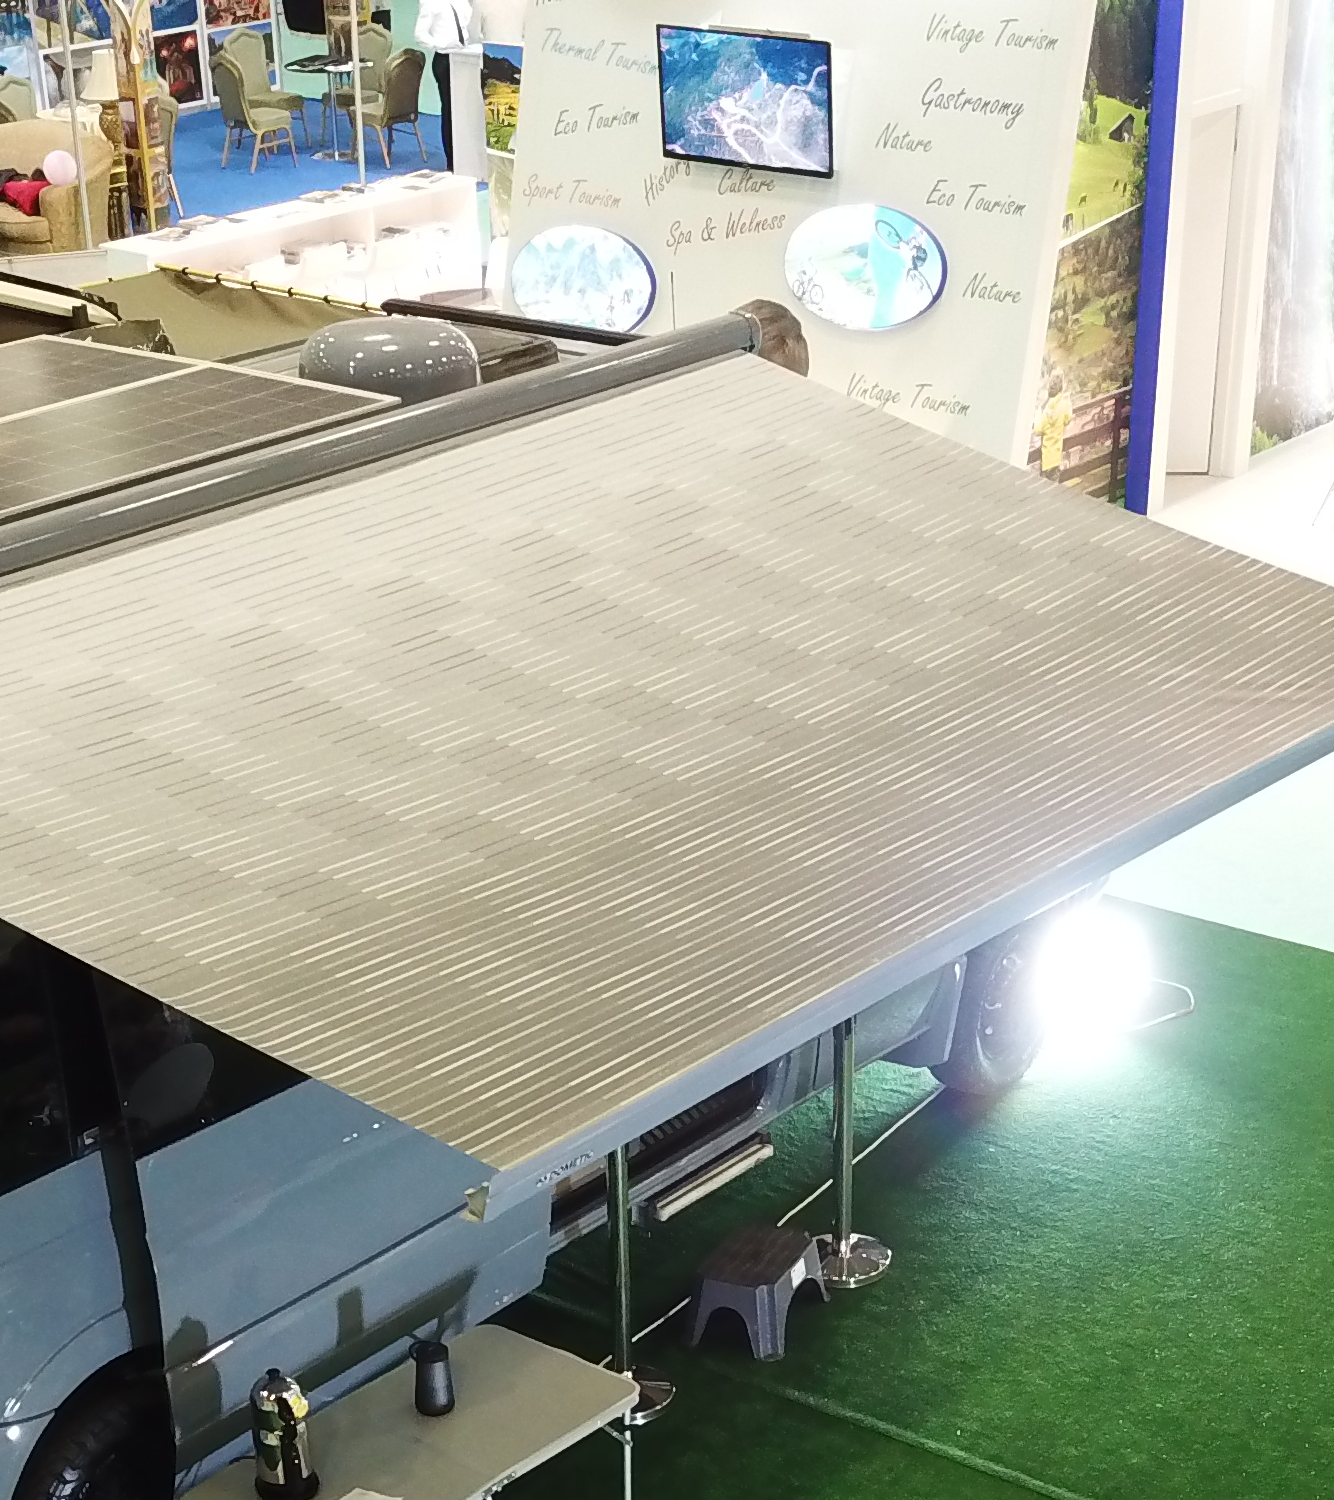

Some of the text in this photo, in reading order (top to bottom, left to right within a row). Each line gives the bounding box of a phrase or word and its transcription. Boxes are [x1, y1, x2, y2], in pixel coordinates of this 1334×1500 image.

[541, 27, 658, 76] Thermal Tourism
[926, 12, 1060, 54] Vintage Tourism
[554, 103, 640, 136] Eco Tourism
[921, 77, 1025, 130] Gastronomy
[875, 122, 933, 152] Nature
[522, 173, 622, 208] Sport Tourism
[643, 160, 691, 206] History
[718, 167, 776, 195] Culture
[925, 179, 1027, 217] Eco Tourism
[666, 207, 787, 256] Spa & Welness
[962, 272, 1022, 305] Nature
[846, 372, 971, 417] Vintage Tourism
